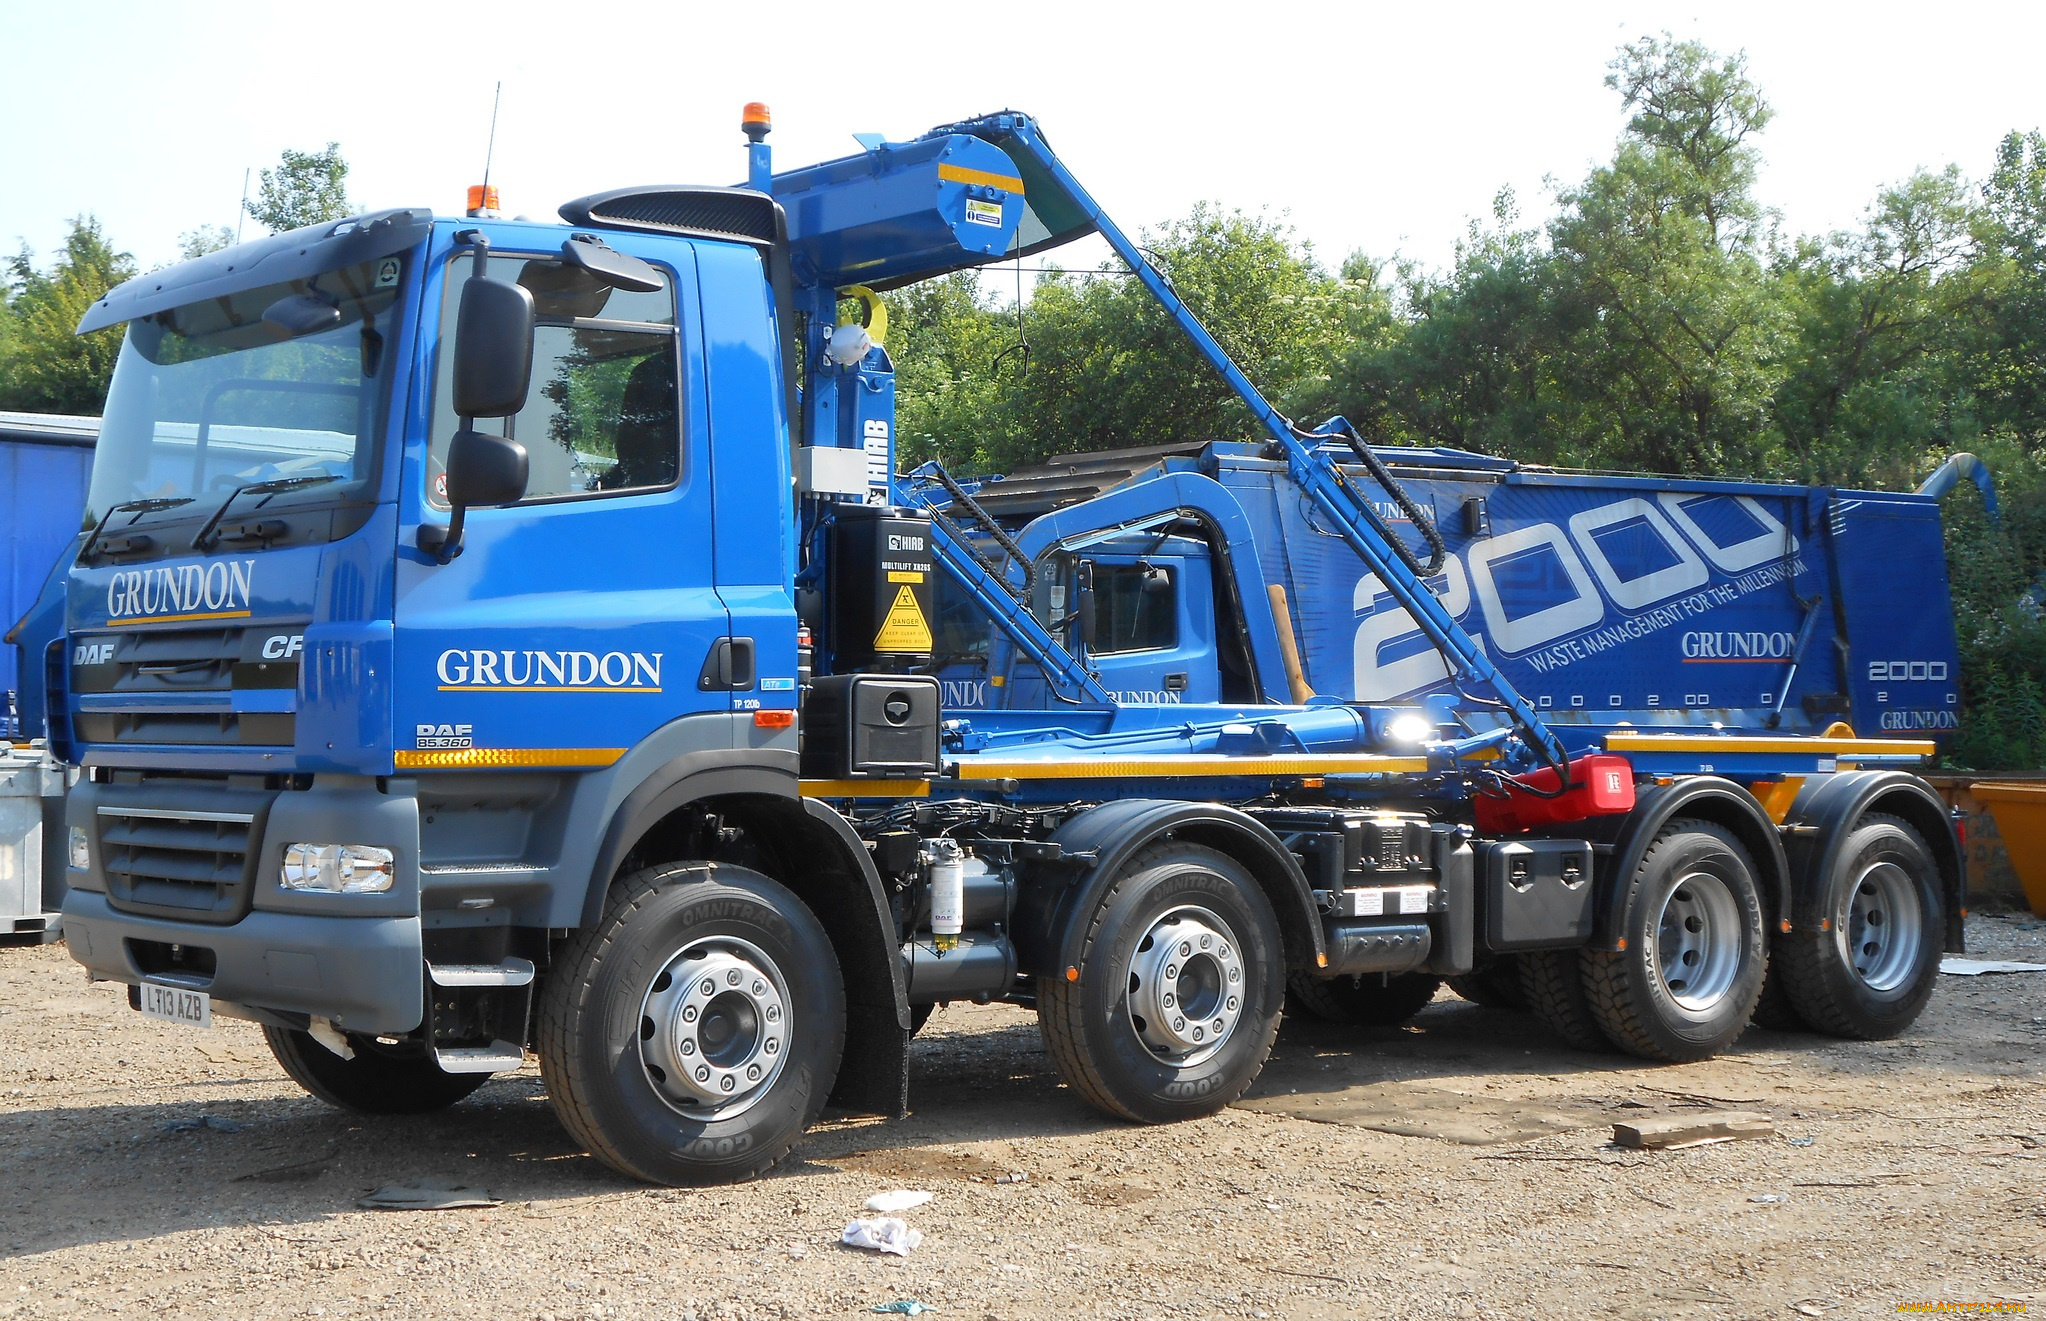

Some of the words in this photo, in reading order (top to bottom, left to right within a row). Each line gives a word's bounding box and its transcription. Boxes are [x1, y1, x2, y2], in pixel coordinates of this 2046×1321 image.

[864, 419, 888, 482] HIAB
[902, 536, 924, 551] HIAB
[882, 562, 911, 570] MULTILIFT
[107, 560, 255, 617] GRUNDON
[1526, 640, 1586, 674] WASTE
[1582, 604, 1686, 652] MANAGEMENT
[1682, 594, 1710, 617] FOR
[1708, 583, 1739, 606] THE
[1735, 558, 1809, 596] MILLENNIUM
[73, 644, 115, 665] DAF
[262, 635, 304, 659] CF
[436, 648, 663, 687] GRUNDON
[1869, 661, 1947, 681] 2000
[733, 699, 743, 709] TP
[416, 724, 473, 736] DAF
[1881, 710, 1959, 730] GRUNDON
[417, 738, 472, 748] 85.360
[1153, 875, 1228, 902] OMNITRAC
[682, 901, 779, 930] OMNITRAC
[147, 986, 175, 1016] LT13
[177, 992, 202, 1022] AZB
